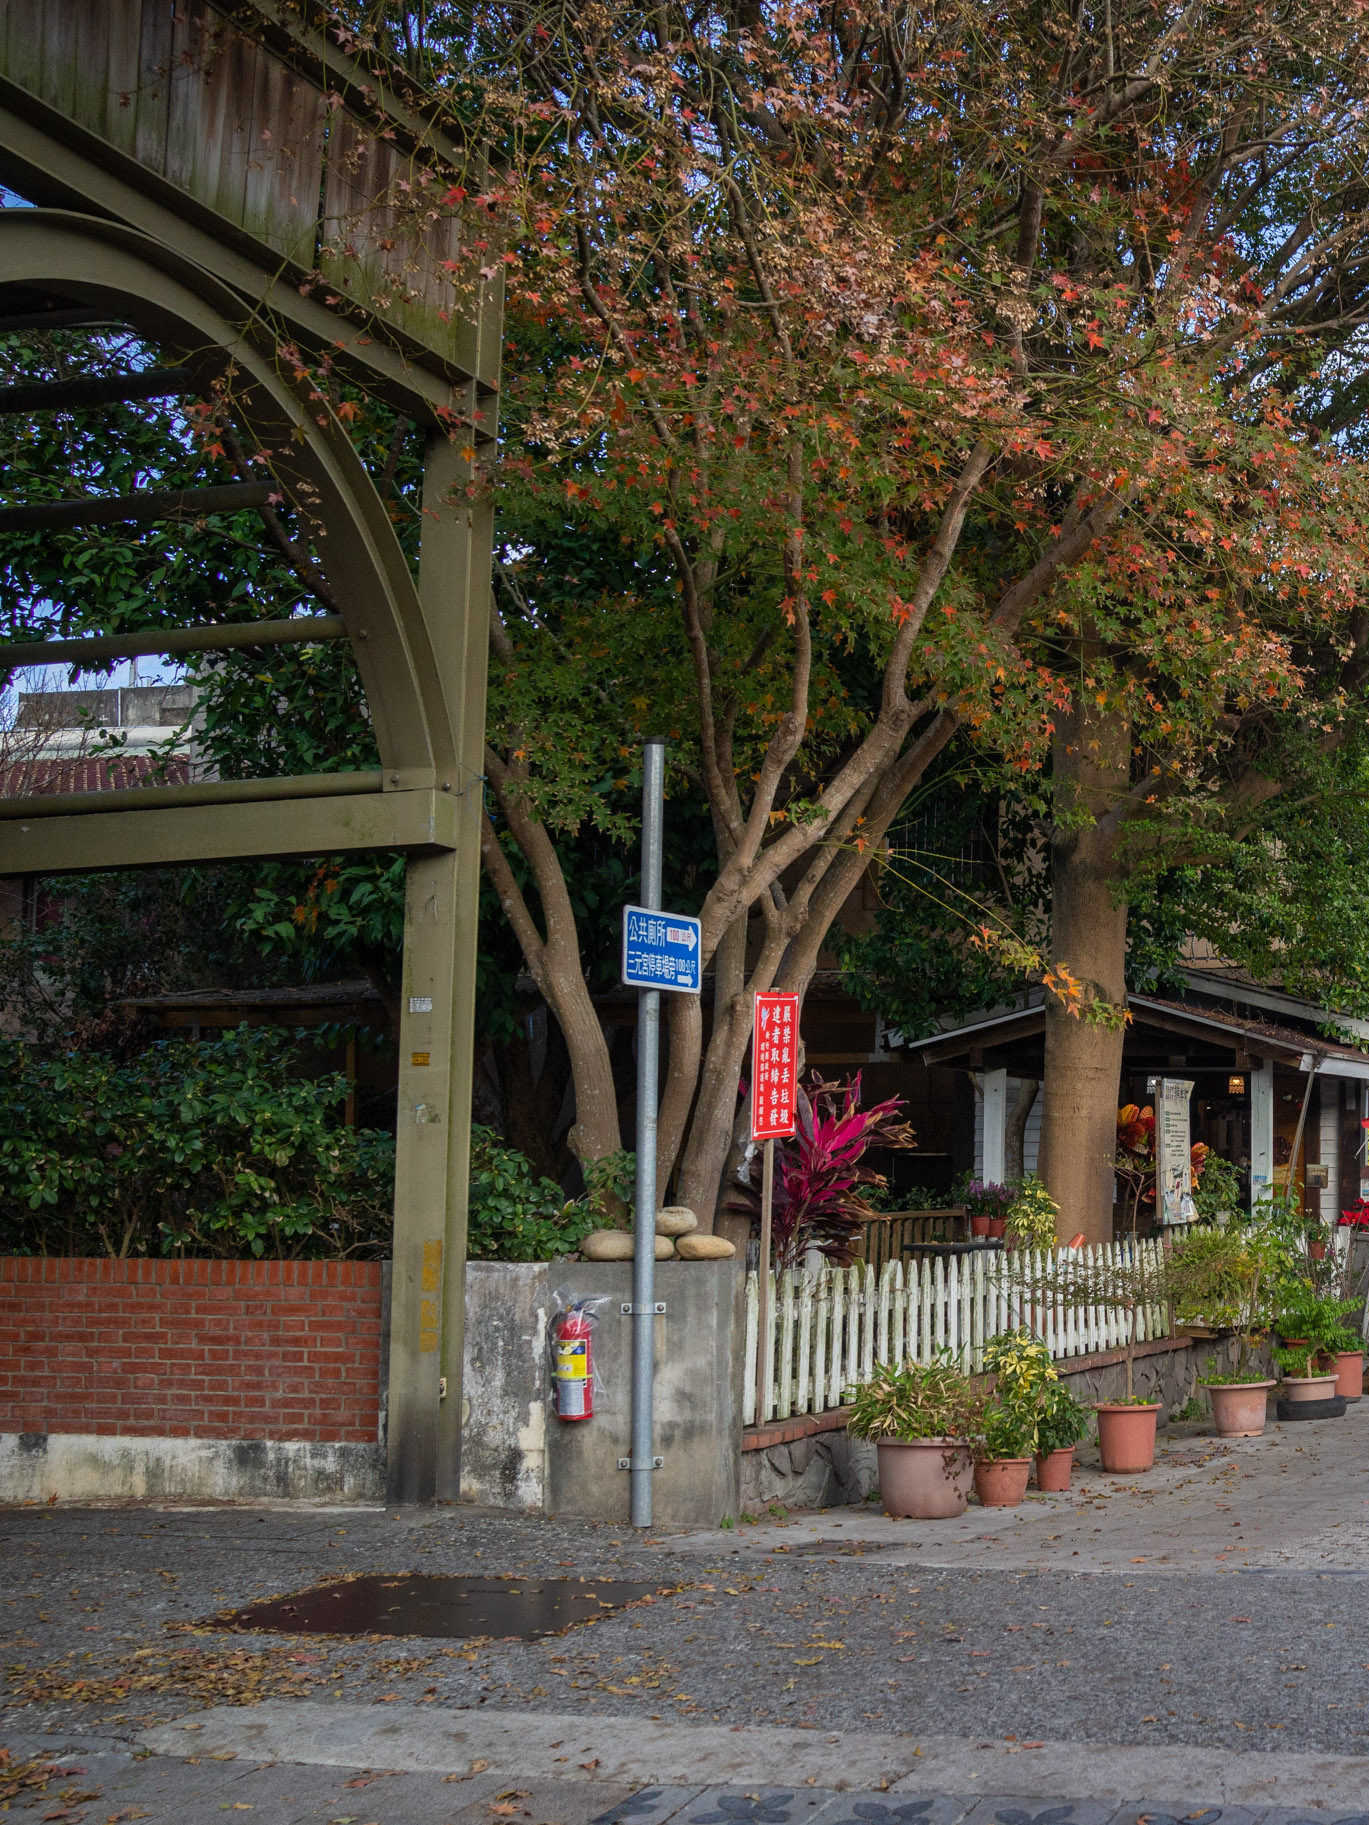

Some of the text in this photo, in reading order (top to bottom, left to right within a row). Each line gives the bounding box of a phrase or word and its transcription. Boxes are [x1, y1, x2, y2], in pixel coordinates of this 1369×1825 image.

[628, 915, 666, 947] 公共廁所
[669, 929, 692, 943] 100 公尺
[769, 1004, 781, 1126] 違者取締告發
[779, 1005, 792, 1124] 嚴禁亂丟垃圾
